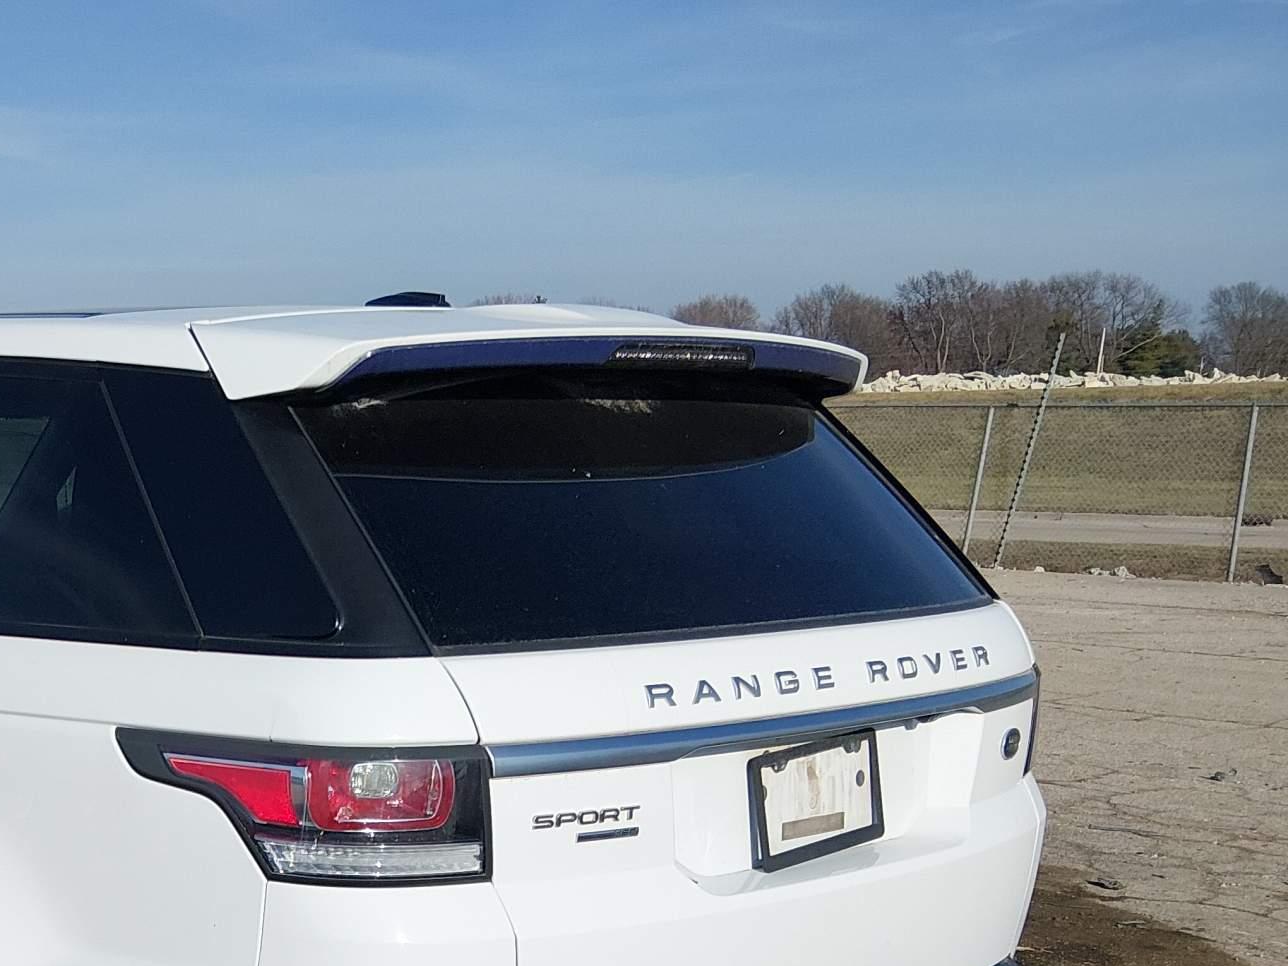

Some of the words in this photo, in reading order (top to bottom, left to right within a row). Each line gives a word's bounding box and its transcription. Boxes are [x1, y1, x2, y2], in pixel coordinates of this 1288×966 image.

[643, 665, 836, 709] RANGE
[865, 645, 991, 684] ROVER
[531, 804, 641, 830] SPORT
